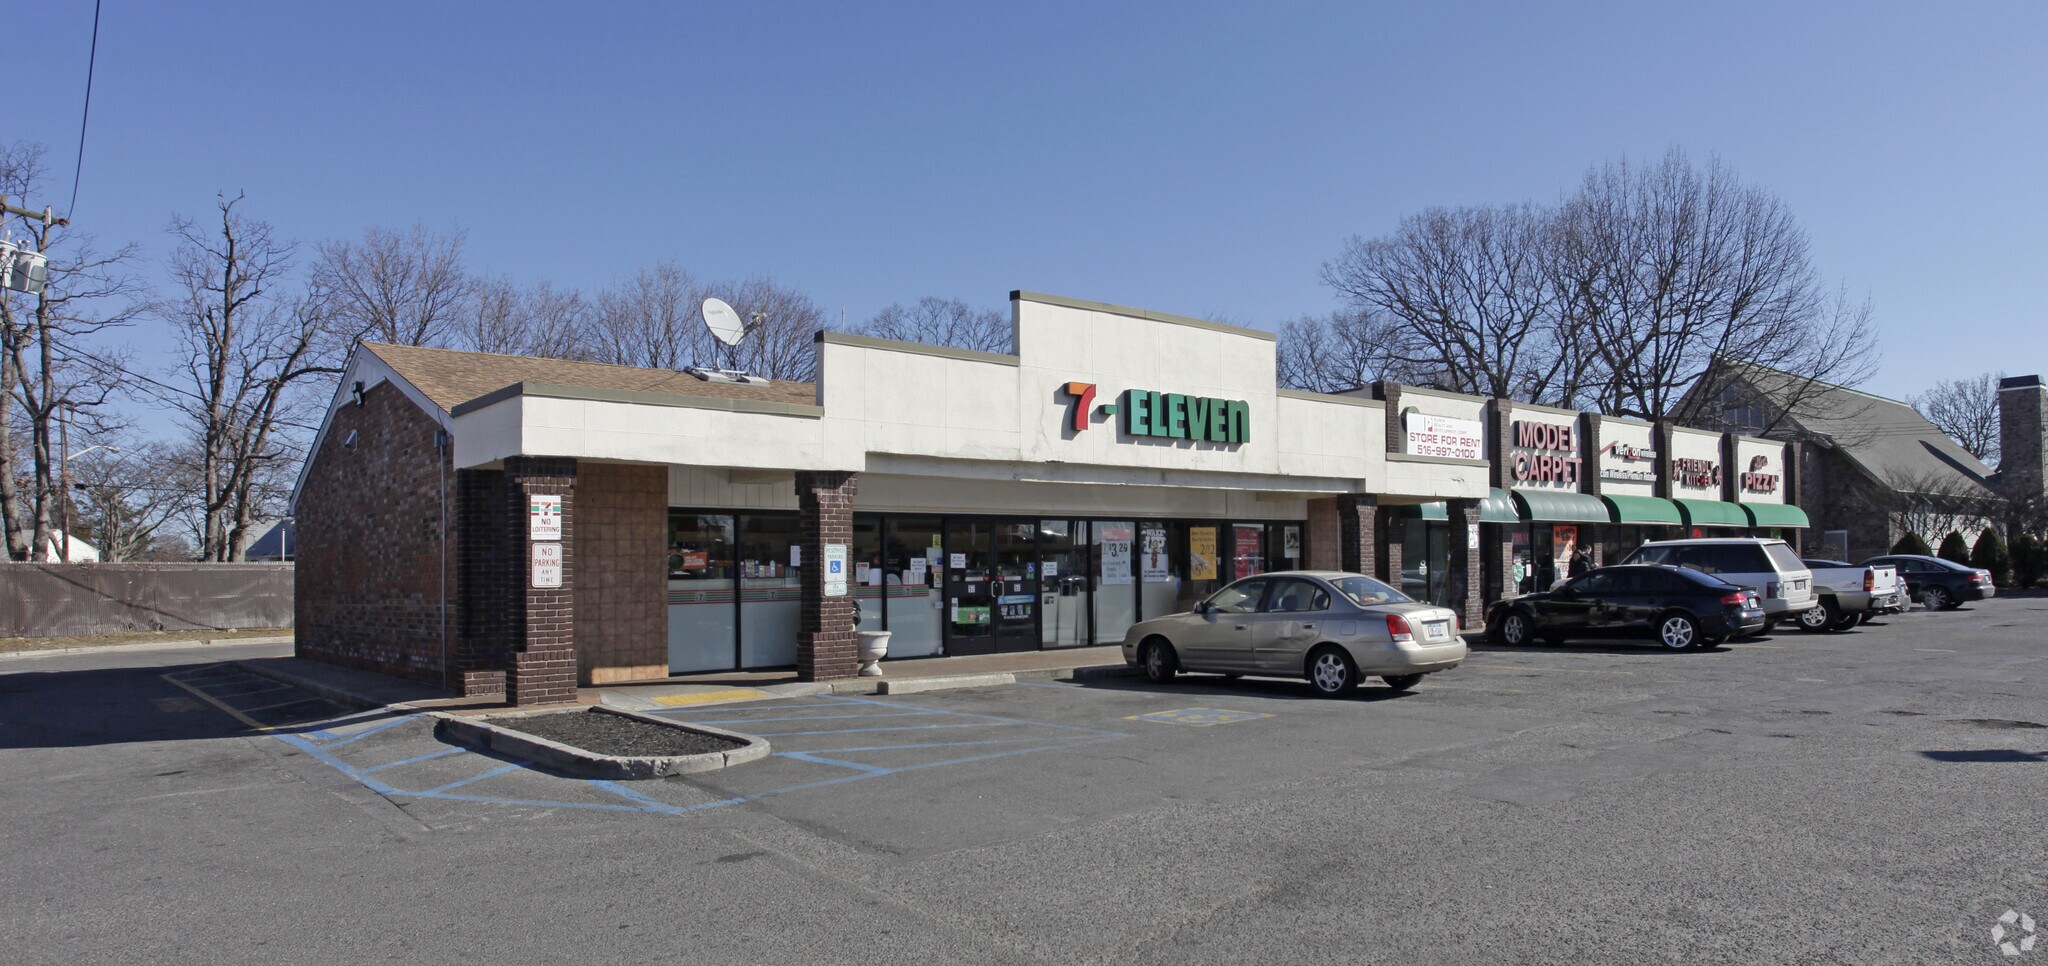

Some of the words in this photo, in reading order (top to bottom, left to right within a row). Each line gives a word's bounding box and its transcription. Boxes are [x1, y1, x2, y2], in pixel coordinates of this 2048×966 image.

[1409, 432, 1438, 444] STORE
[1441, 435, 1457, 446] FOR
[1460, 437, 1481, 448] RENT
[1518, 420, 1578, 452] MODEL
[1417, 444, 1475, 459] 516-997-0100
[1615, 445, 1641, 460] verizon
[1515, 452, 1583, 483] CARPET
[1682, 458, 1714, 473] FRIENDLY
[1745, 472, 1777, 491] PIZZA
[541, 518, 551, 526] NO
[1146, 528, 1164, 537] WAKE
[541, 547, 553, 557] NO
[534, 558, 560, 568] PARKING
